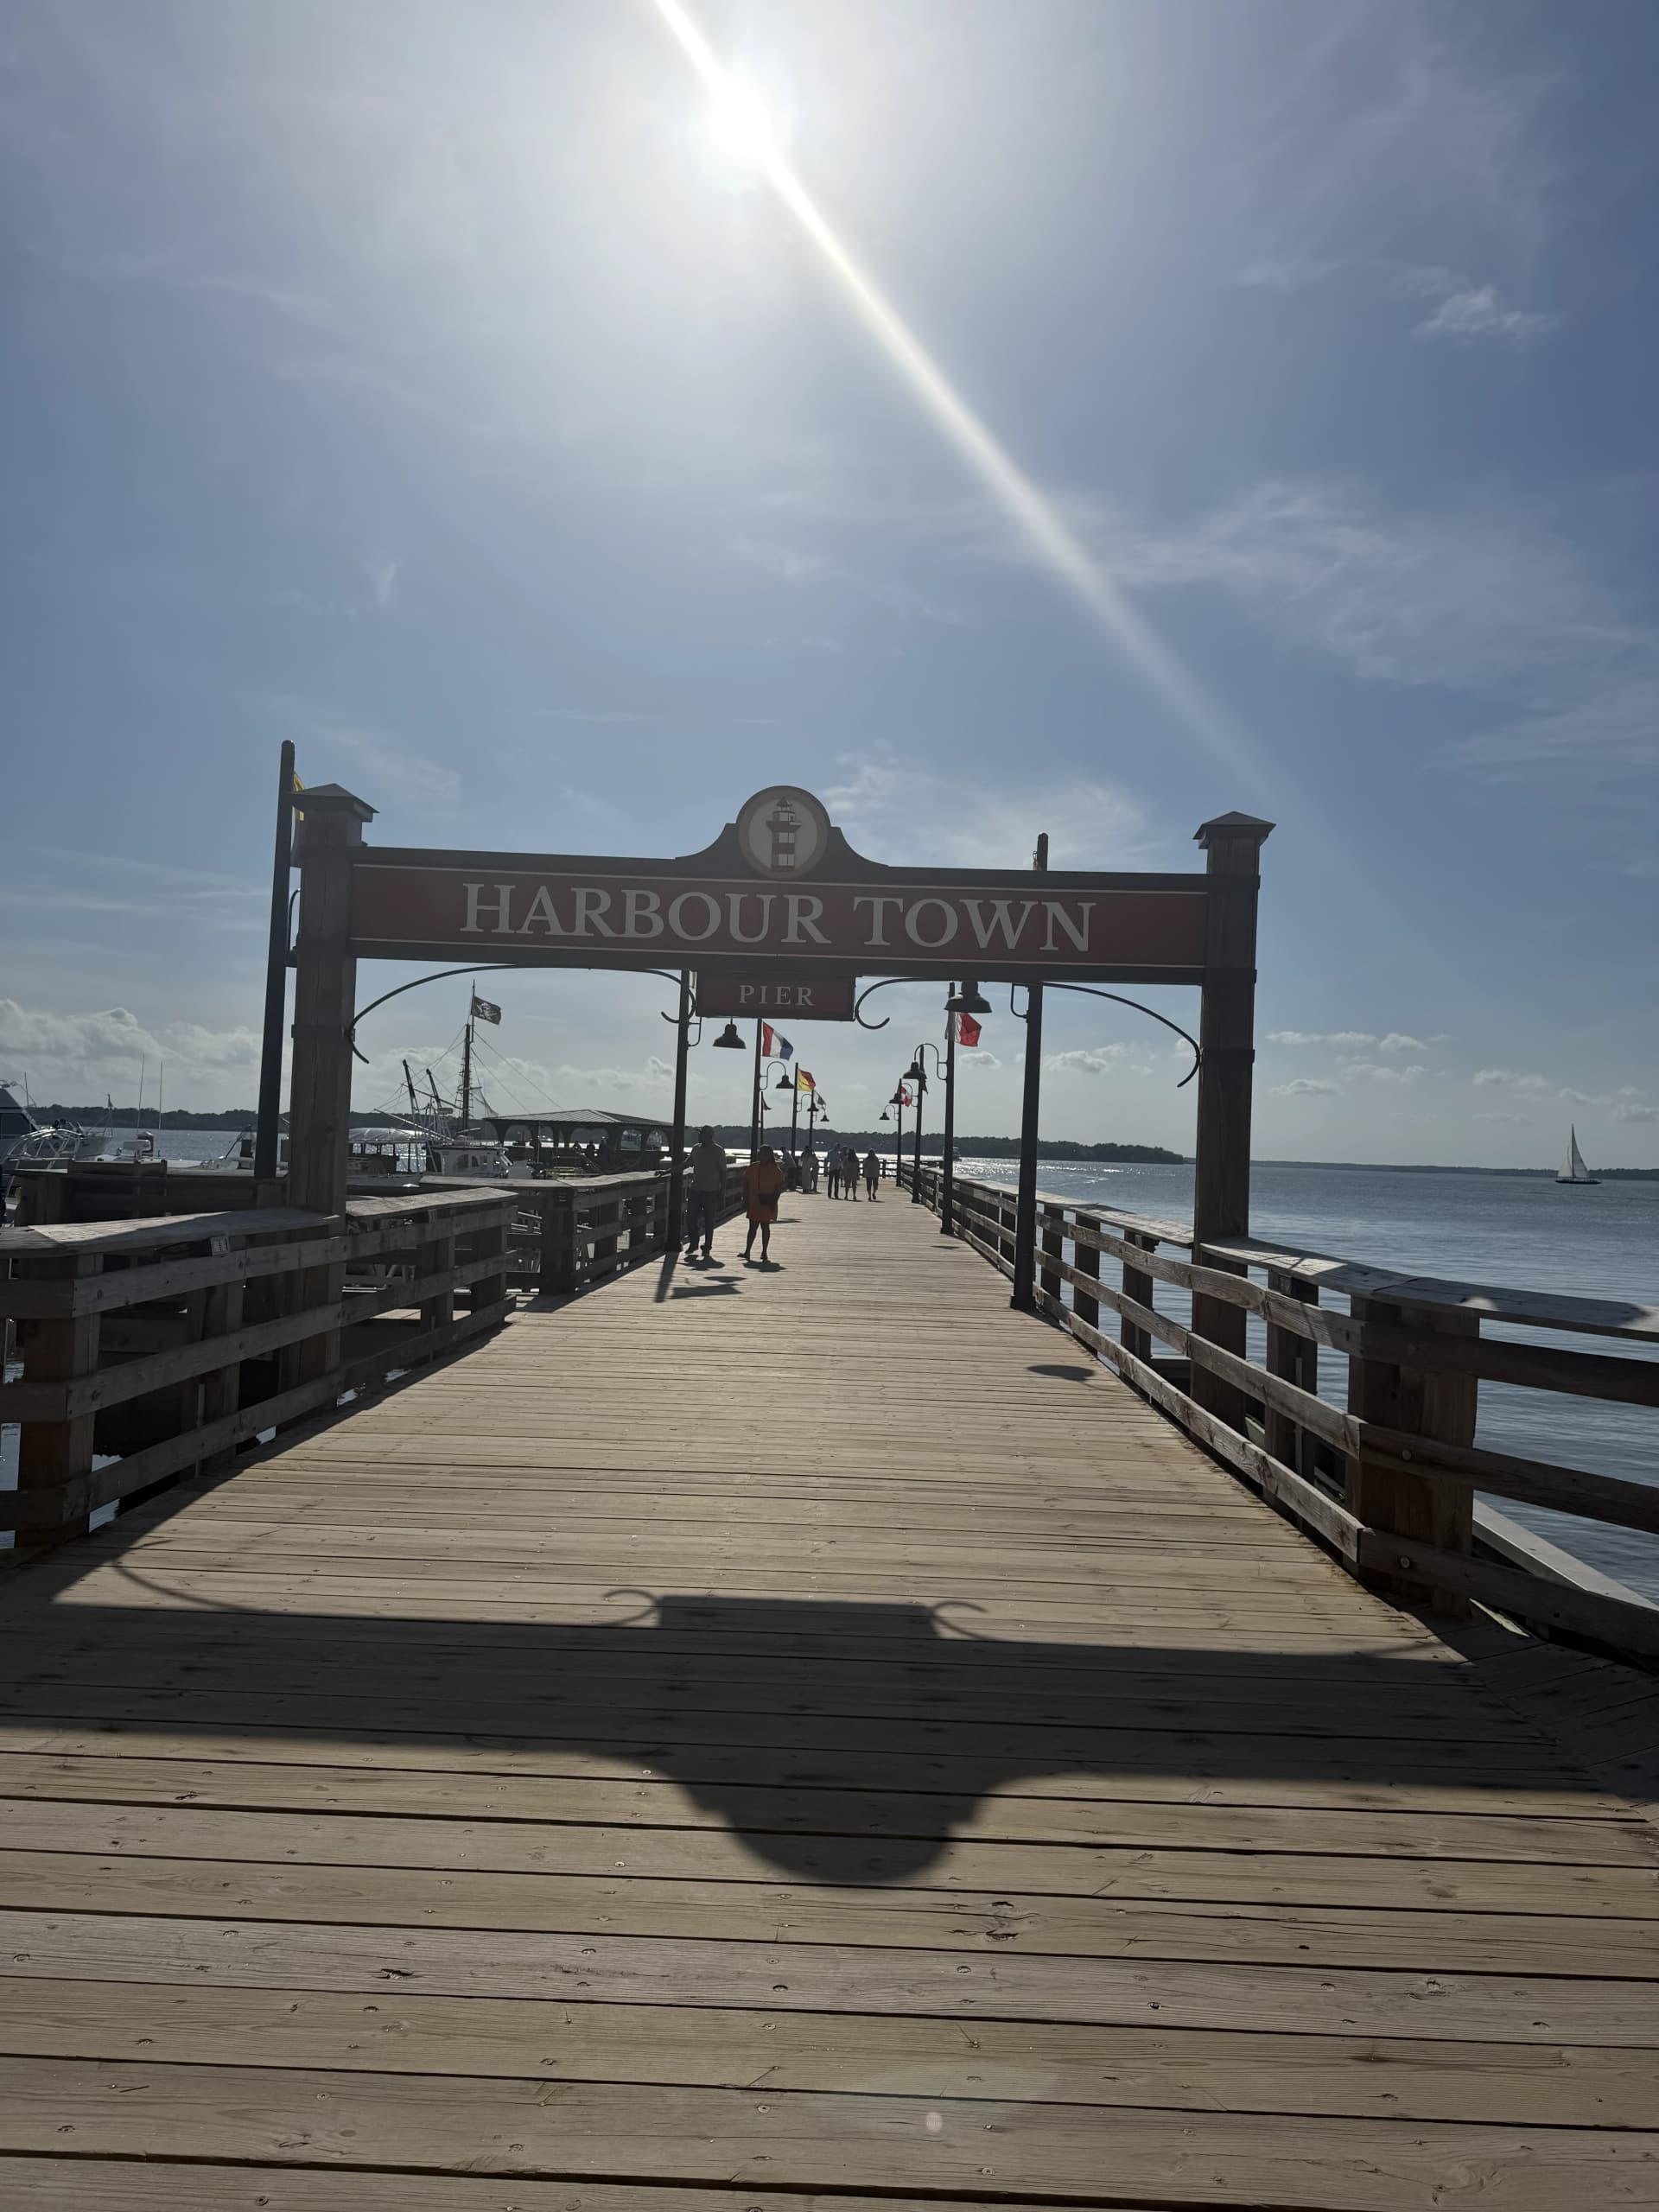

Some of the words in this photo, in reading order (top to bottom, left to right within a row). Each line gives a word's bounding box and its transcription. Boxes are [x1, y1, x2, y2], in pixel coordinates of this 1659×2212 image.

[460, 882, 832, 944] HARBOUR
[853, 896, 1097, 952] TOWN
[739, 984, 817, 1007] PIER
